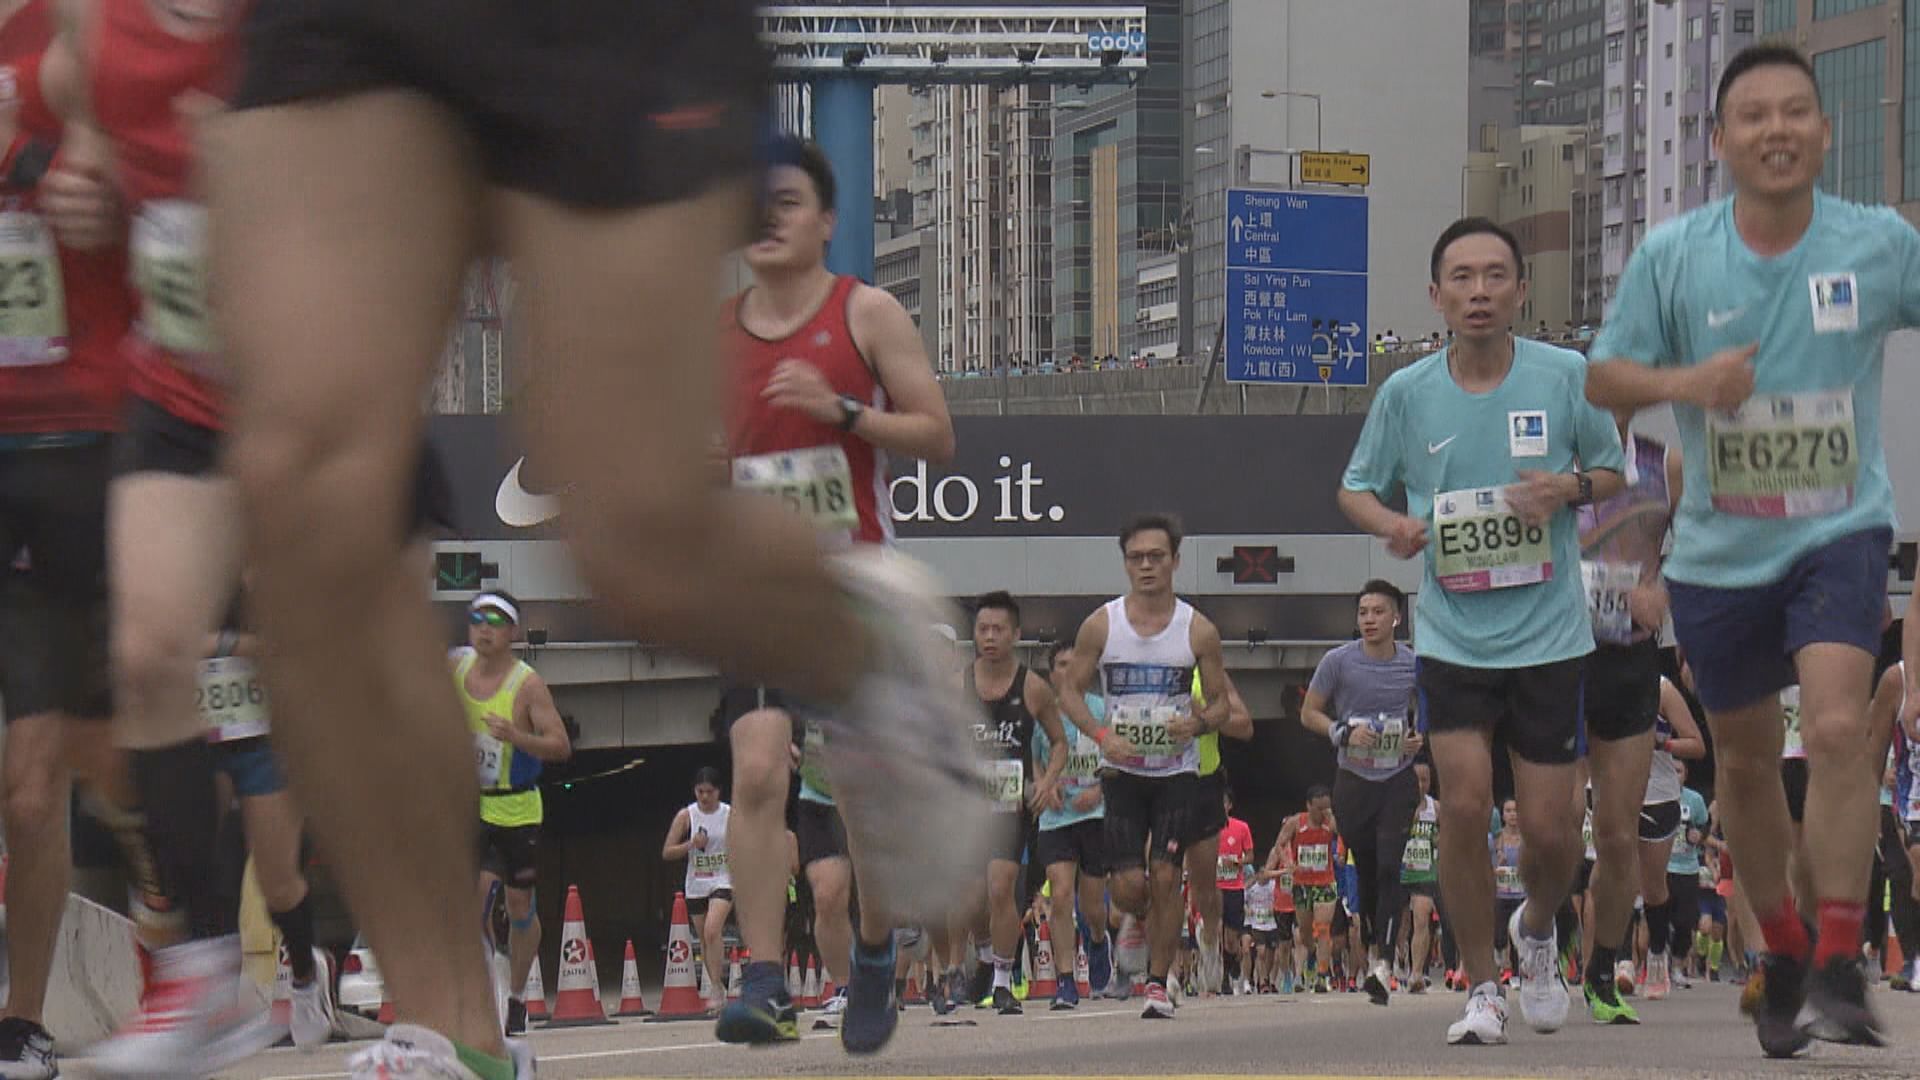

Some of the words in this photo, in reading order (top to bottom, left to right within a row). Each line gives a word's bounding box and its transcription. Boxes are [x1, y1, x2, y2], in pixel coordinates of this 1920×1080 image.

[1088, 32, 1144, 51] cody
[1245, 194, 1280, 209] Sheung
[1286, 196, 1308, 209] Wan
[1245, 211, 1272, 228] 上環
[1244, 229, 1280, 243] Central
[1265, 273, 1287, 288] Ying
[1292, 275, 1311, 288] Pun
[1243, 308, 1261, 320] Pok
[1268, 309, 1281, 321] Fu
[1286, 310, 1308, 322] Lam
[1243, 343, 1284, 356] Kowloon
[1290, 344, 1312, 358] (W)
[1717, 426, 1849, 472] E6279
[889, 458, 979, 522] do
[993, 455, 1065, 522] it.
[1115, 723, 1177, 746] E382
